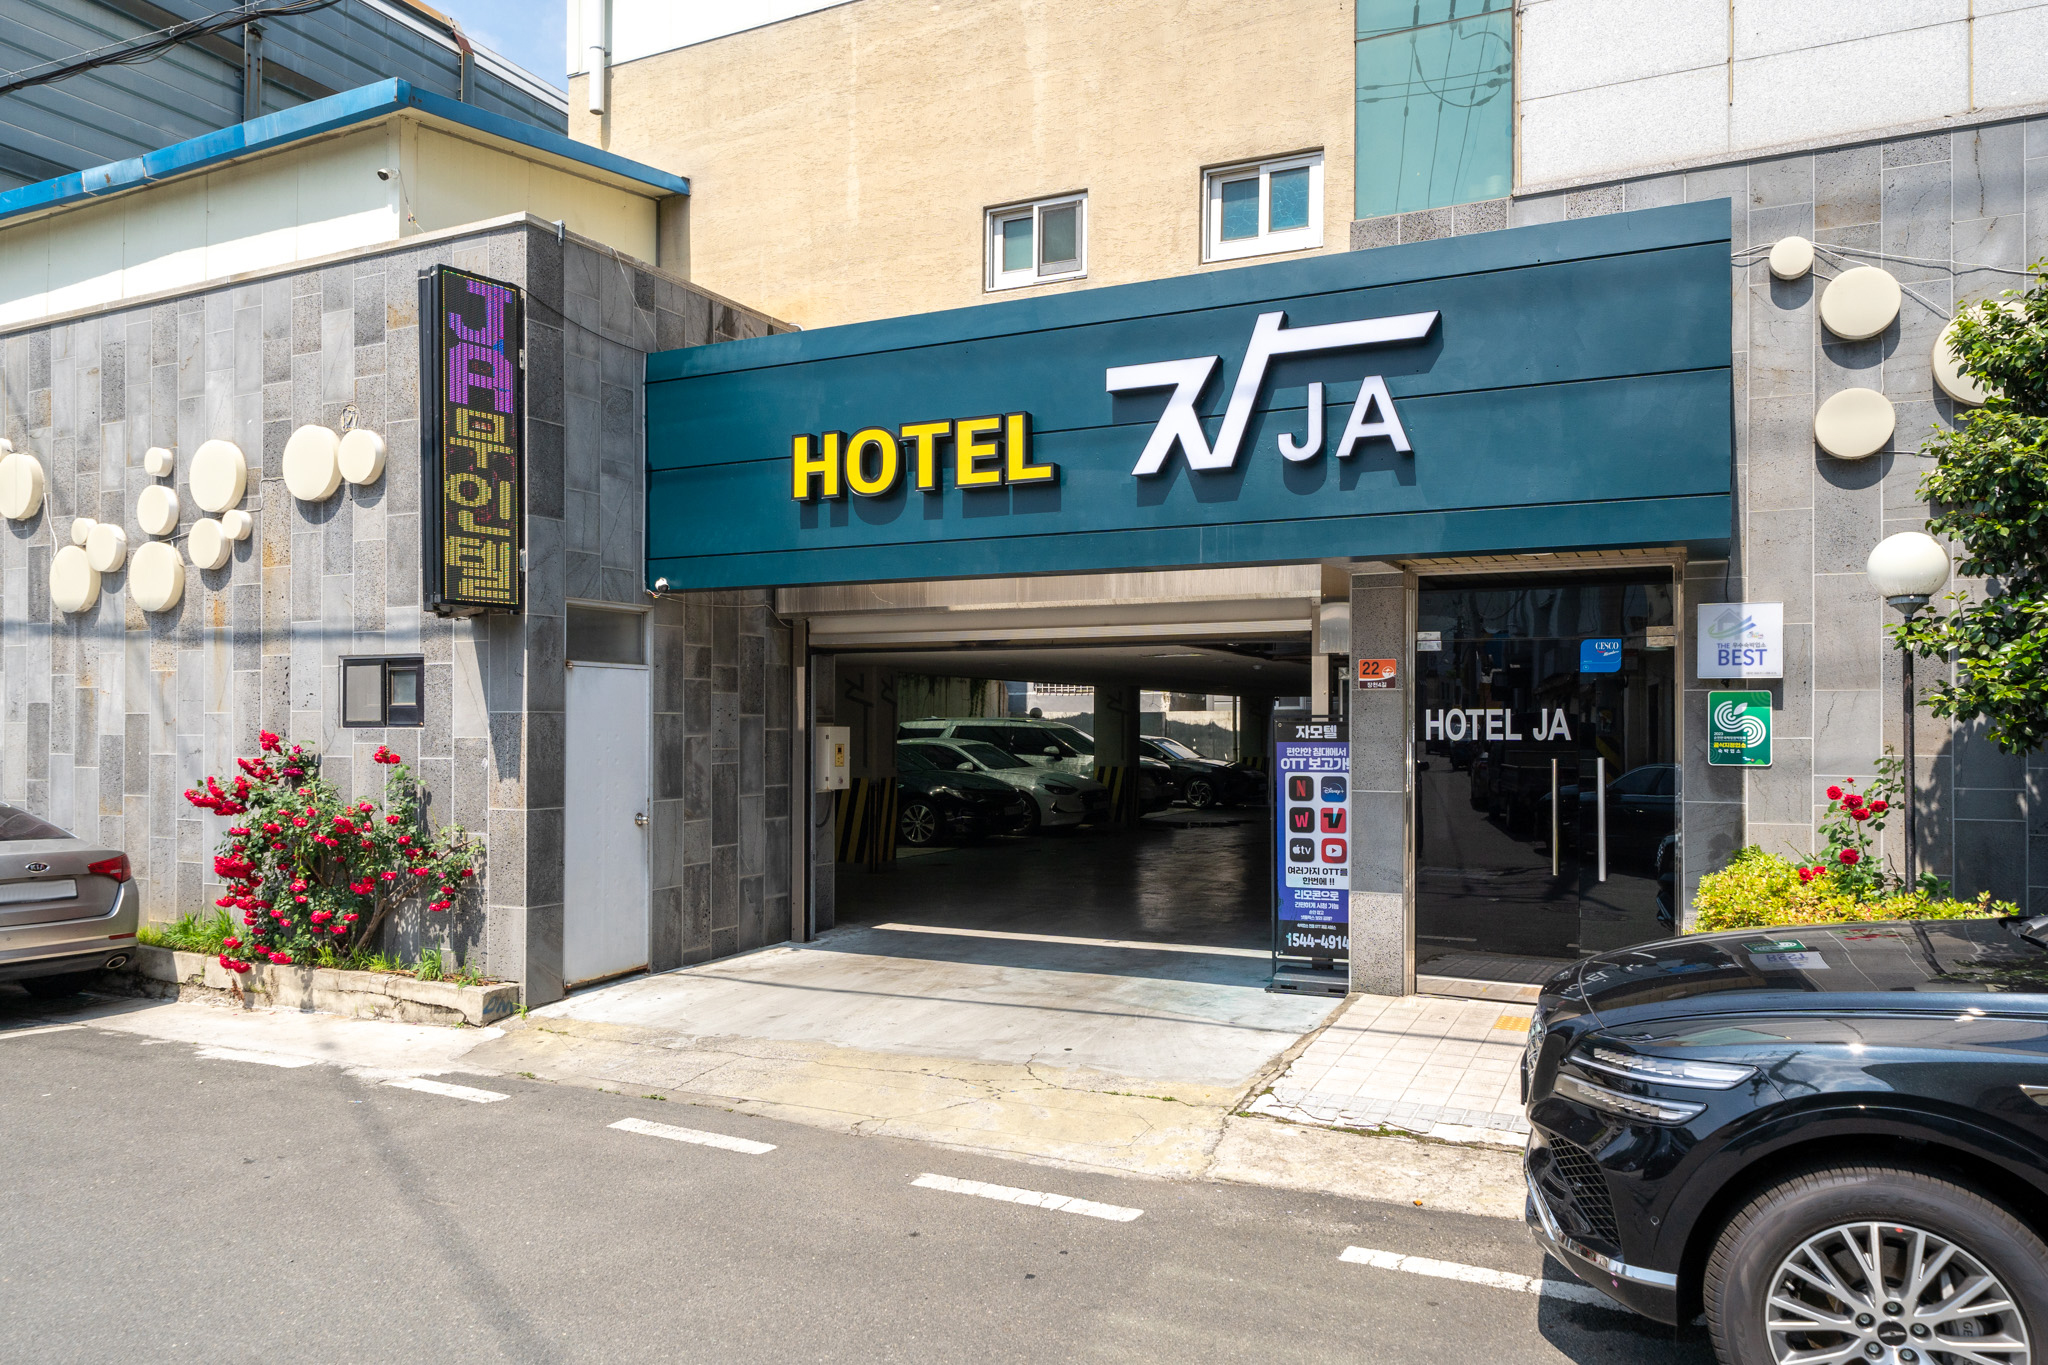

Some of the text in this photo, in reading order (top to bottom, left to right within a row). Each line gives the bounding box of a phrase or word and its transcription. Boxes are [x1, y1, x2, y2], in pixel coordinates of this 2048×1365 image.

[1277, 375, 1414, 462] JA
[791, 411, 1057, 502] HOTEL
[1595, 641, 1619, 650] CESCO
[1718, 649, 1767, 666] BEST
[1362, 661, 1380, 675] 22
[1295, 724, 1338, 740] 자모텔
[1425, 708, 1572, 741] HOTEL JA
[1286, 747, 1347, 757] 편안한 침대에서
[1280, 757, 1307, 770] OTT
[1296, 779, 1344, 797] N Disney+
[1294, 811, 1309, 828] W
[29, 862, 47, 872] KIA
[1287, 866, 1348, 877] 여러가지 OTT를
[1302, 876, 1327, 886] 한번에
[1294, 889, 1340, 901] 리모콘으로
[1285, 932, 1349, 950] 1544-4914
